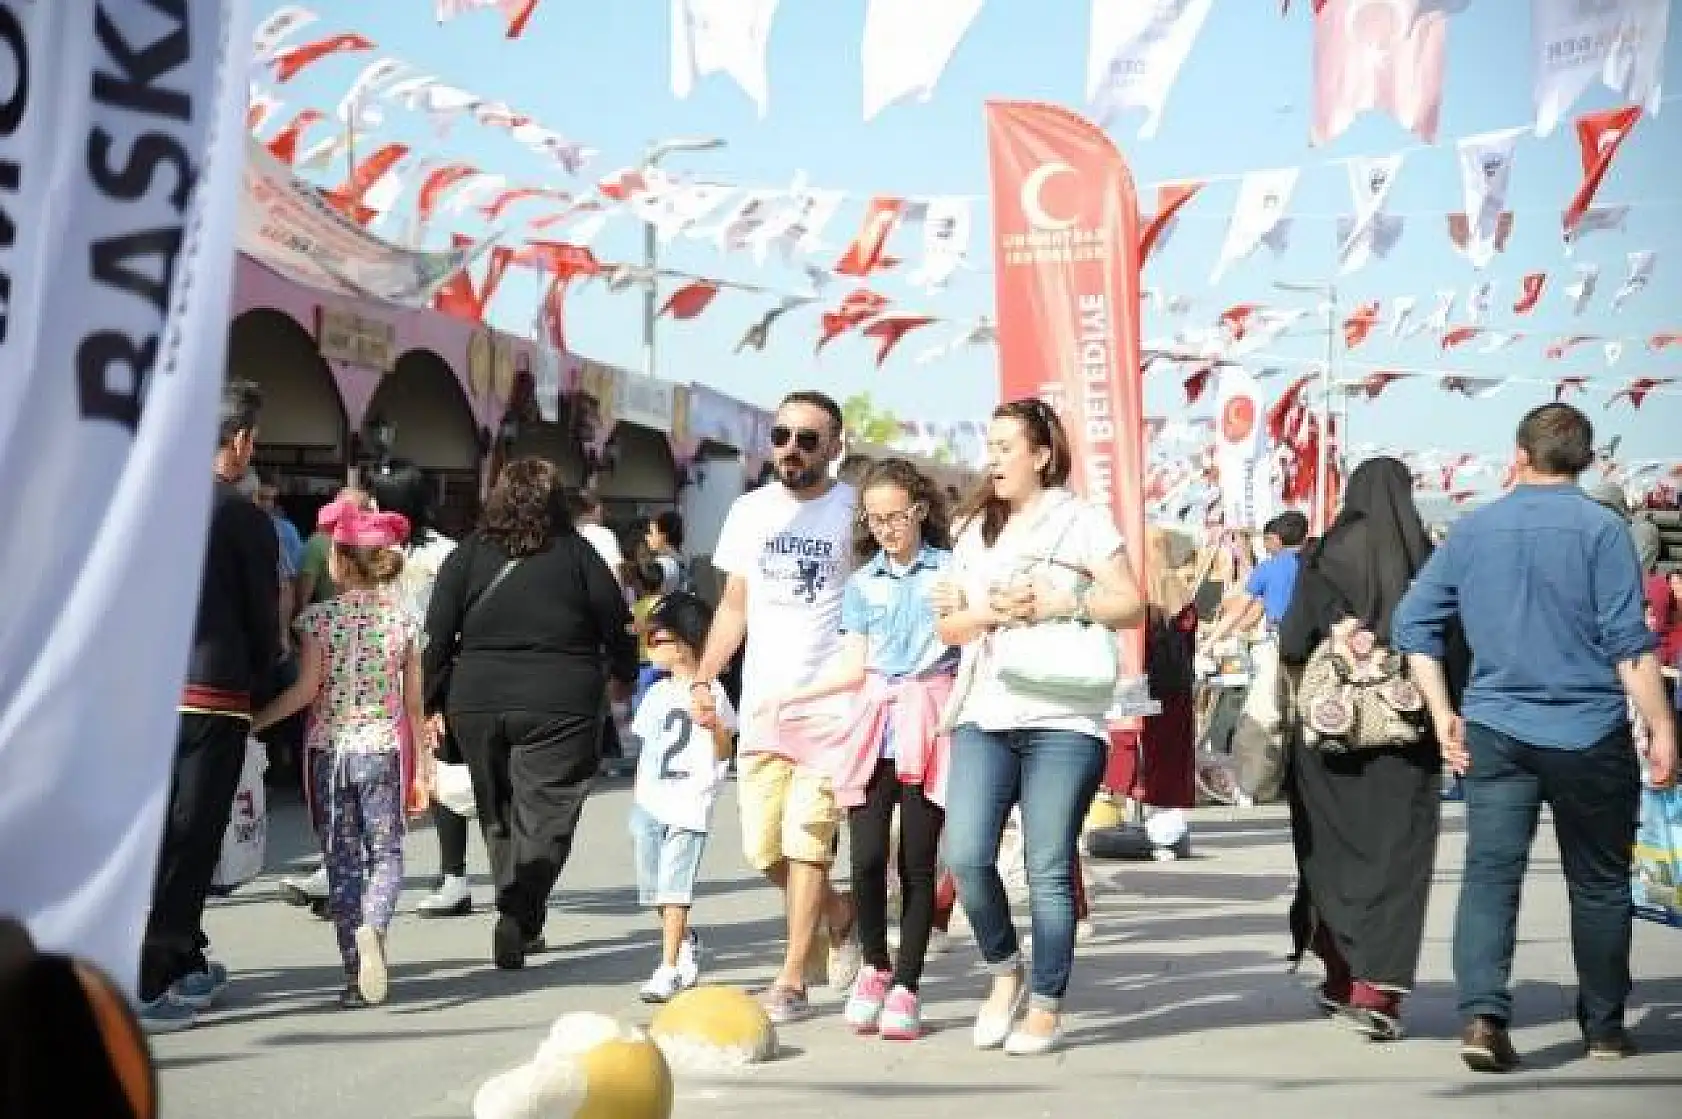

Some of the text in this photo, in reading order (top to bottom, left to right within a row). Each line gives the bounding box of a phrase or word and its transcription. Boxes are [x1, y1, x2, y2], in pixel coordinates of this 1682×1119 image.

[75, 0, 197, 437] BASK
[763, 534, 833, 556] HILFIGER
[660, 707, 692, 780] 2
